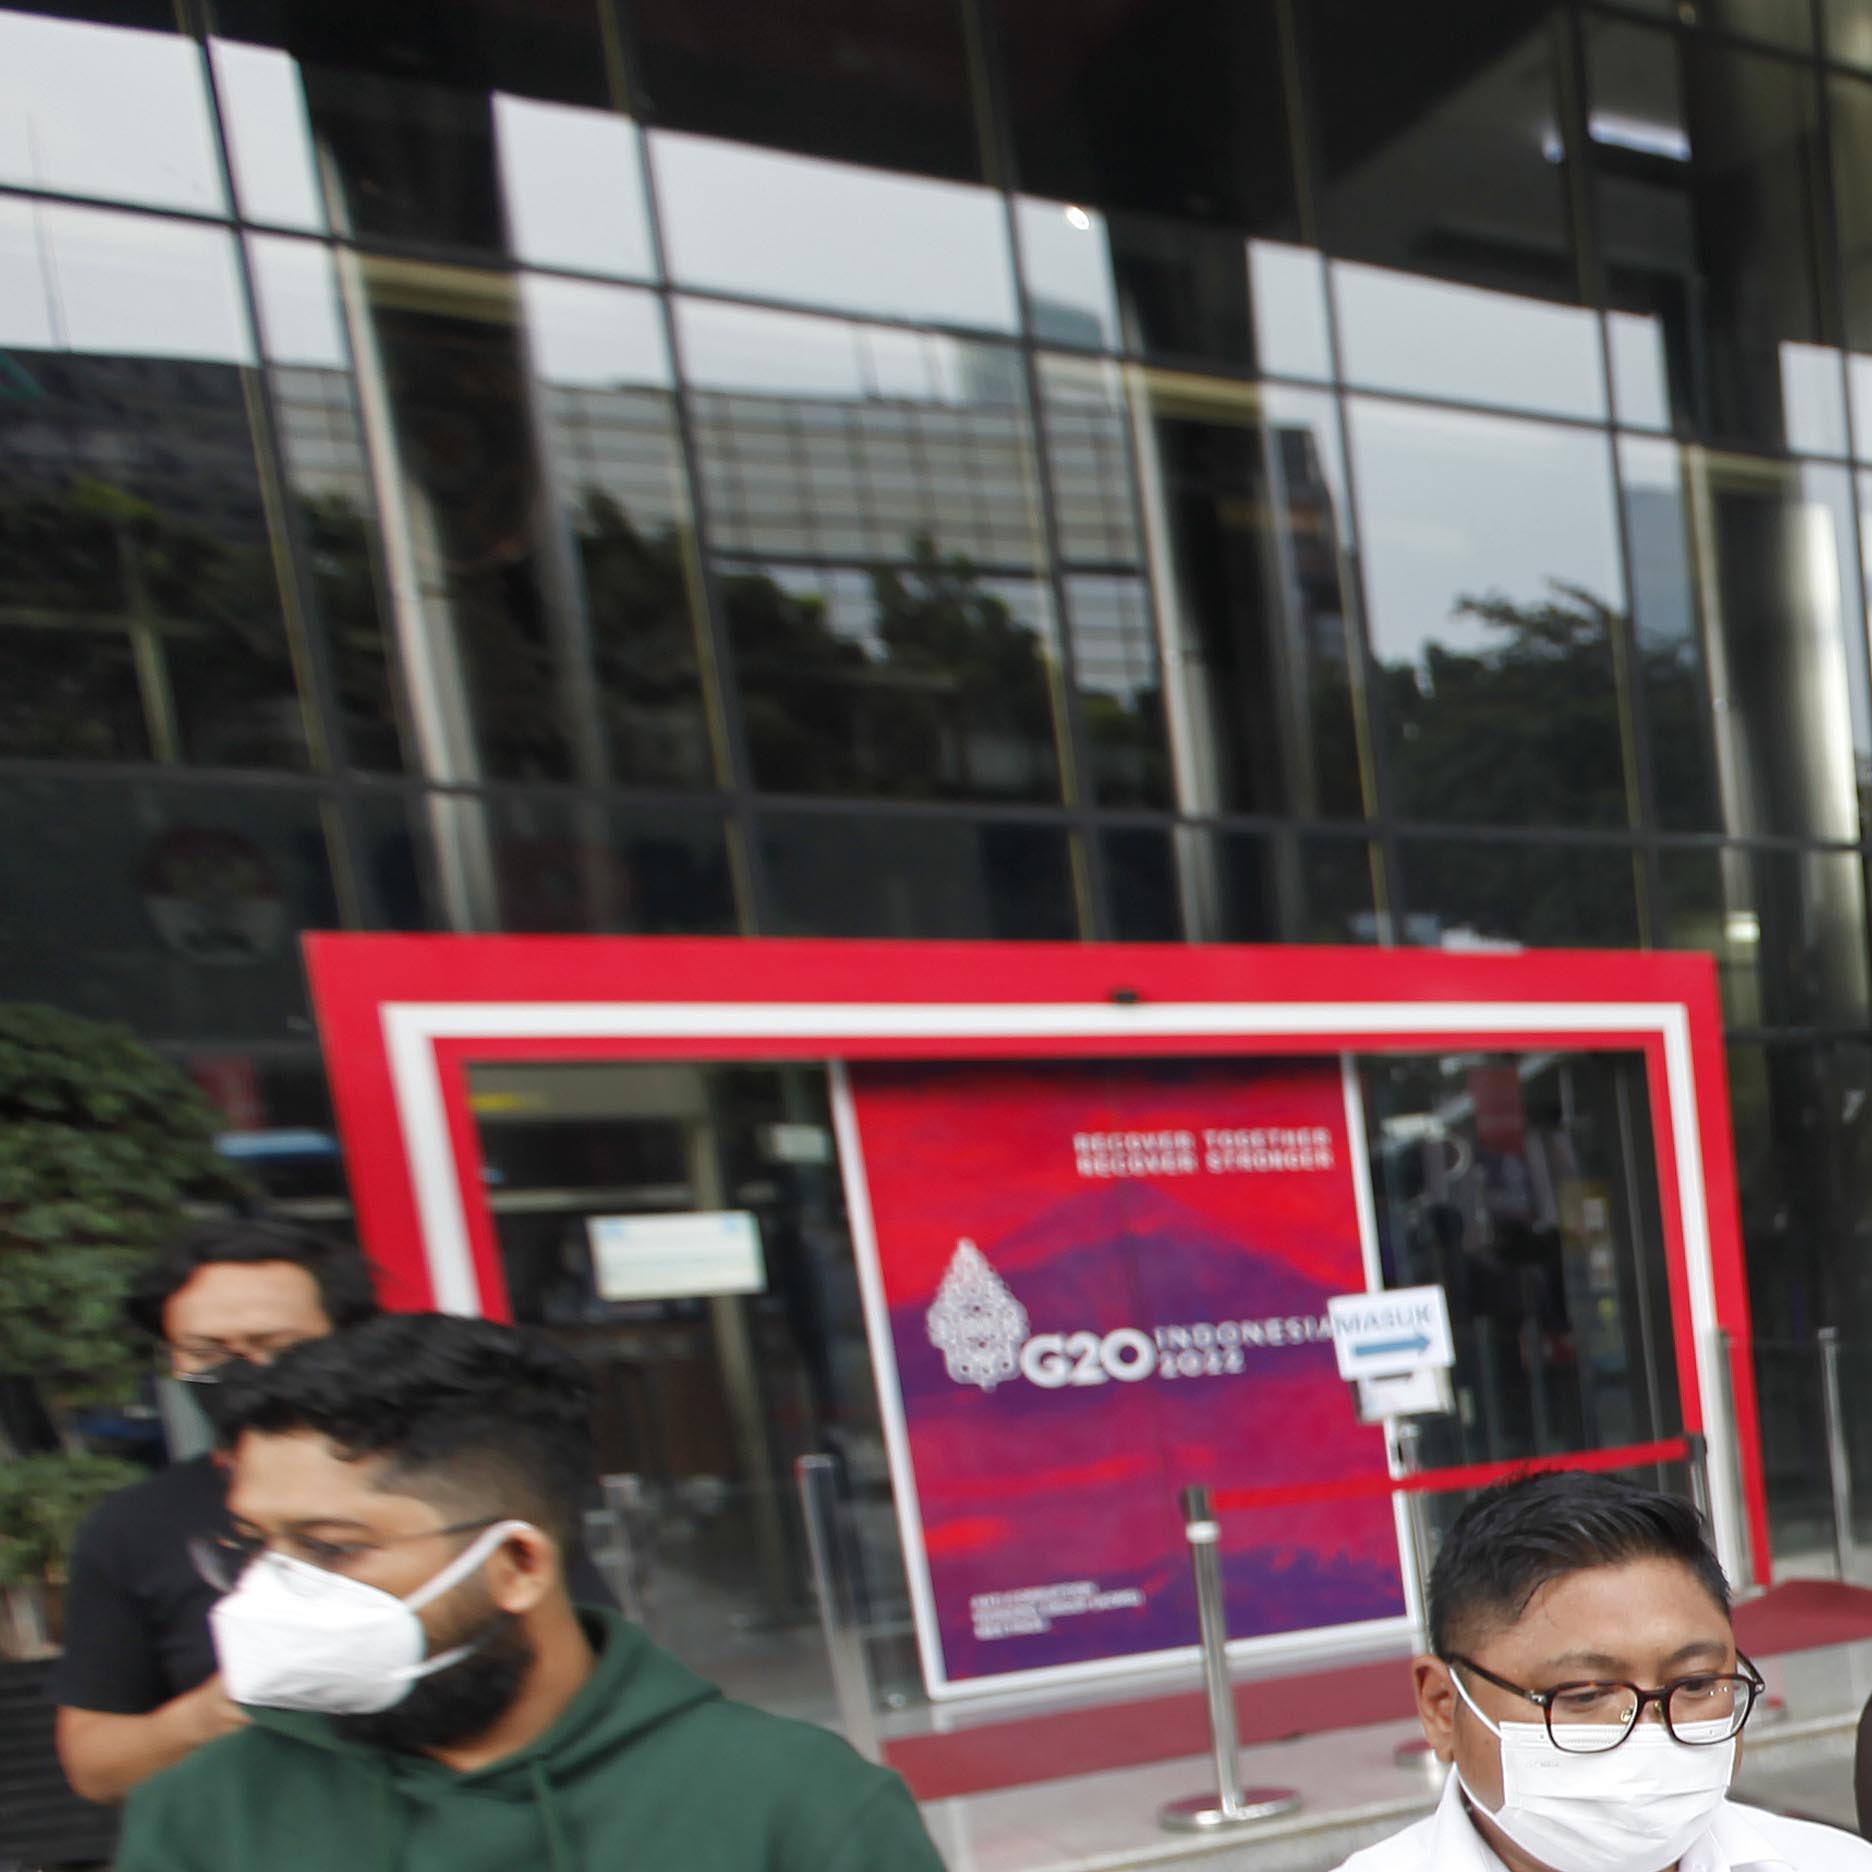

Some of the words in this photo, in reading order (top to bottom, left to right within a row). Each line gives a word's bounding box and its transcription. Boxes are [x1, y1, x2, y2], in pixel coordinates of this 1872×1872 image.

[1074, 1131, 1195, 1153] RECOVER
[1203, 1126, 1332, 1151] TOGETHER
[1076, 1152, 1198, 1177] RECOVER
[1154, 1315, 1333, 1351] INDONESIA
[1334, 1303, 1431, 1334] MASUK
[1020, 1327, 1157, 1388] G20
